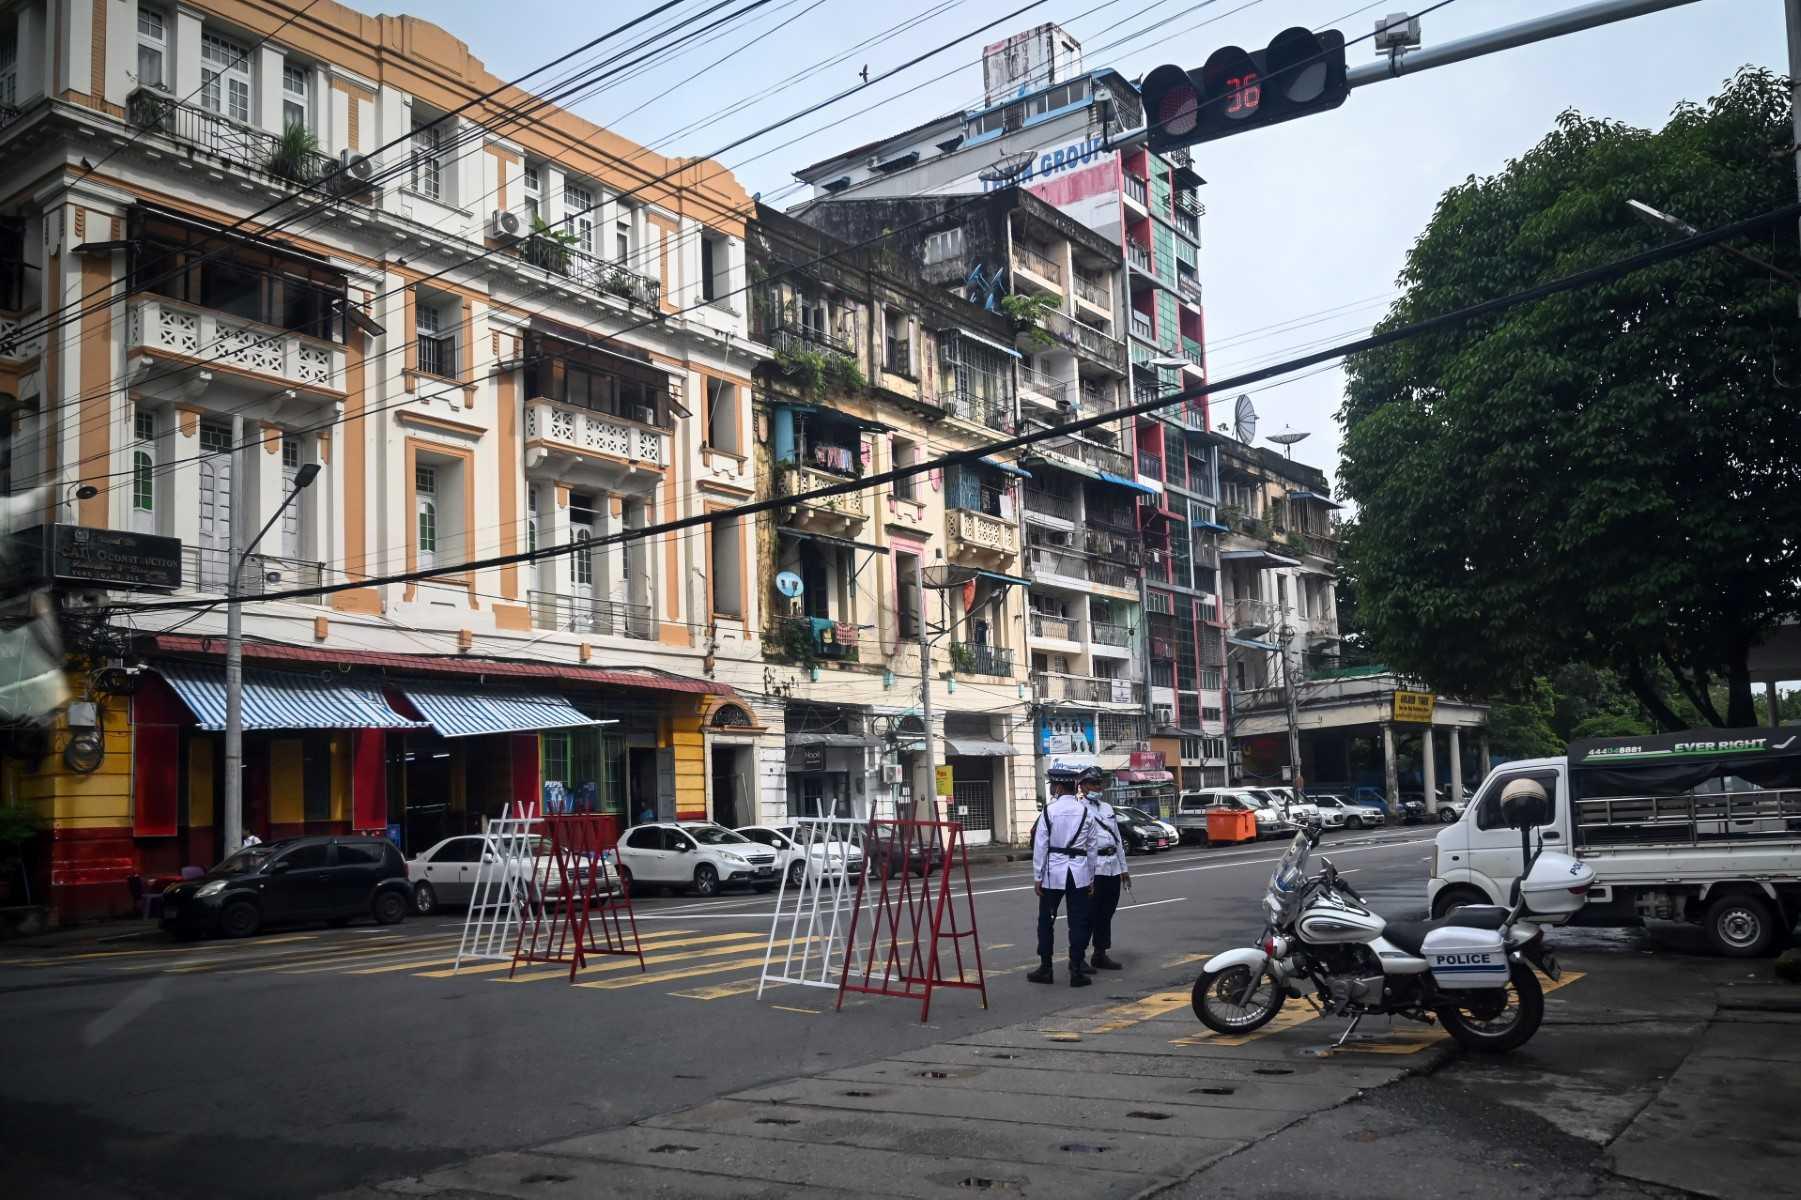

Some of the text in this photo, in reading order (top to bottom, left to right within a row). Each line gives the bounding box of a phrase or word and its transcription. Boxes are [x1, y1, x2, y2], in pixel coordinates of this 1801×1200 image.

[1674, 742, 1715, 753] EVER
[1718, 738, 1767, 751] RIGHT
[1436, 954, 1491, 965] POLICE
